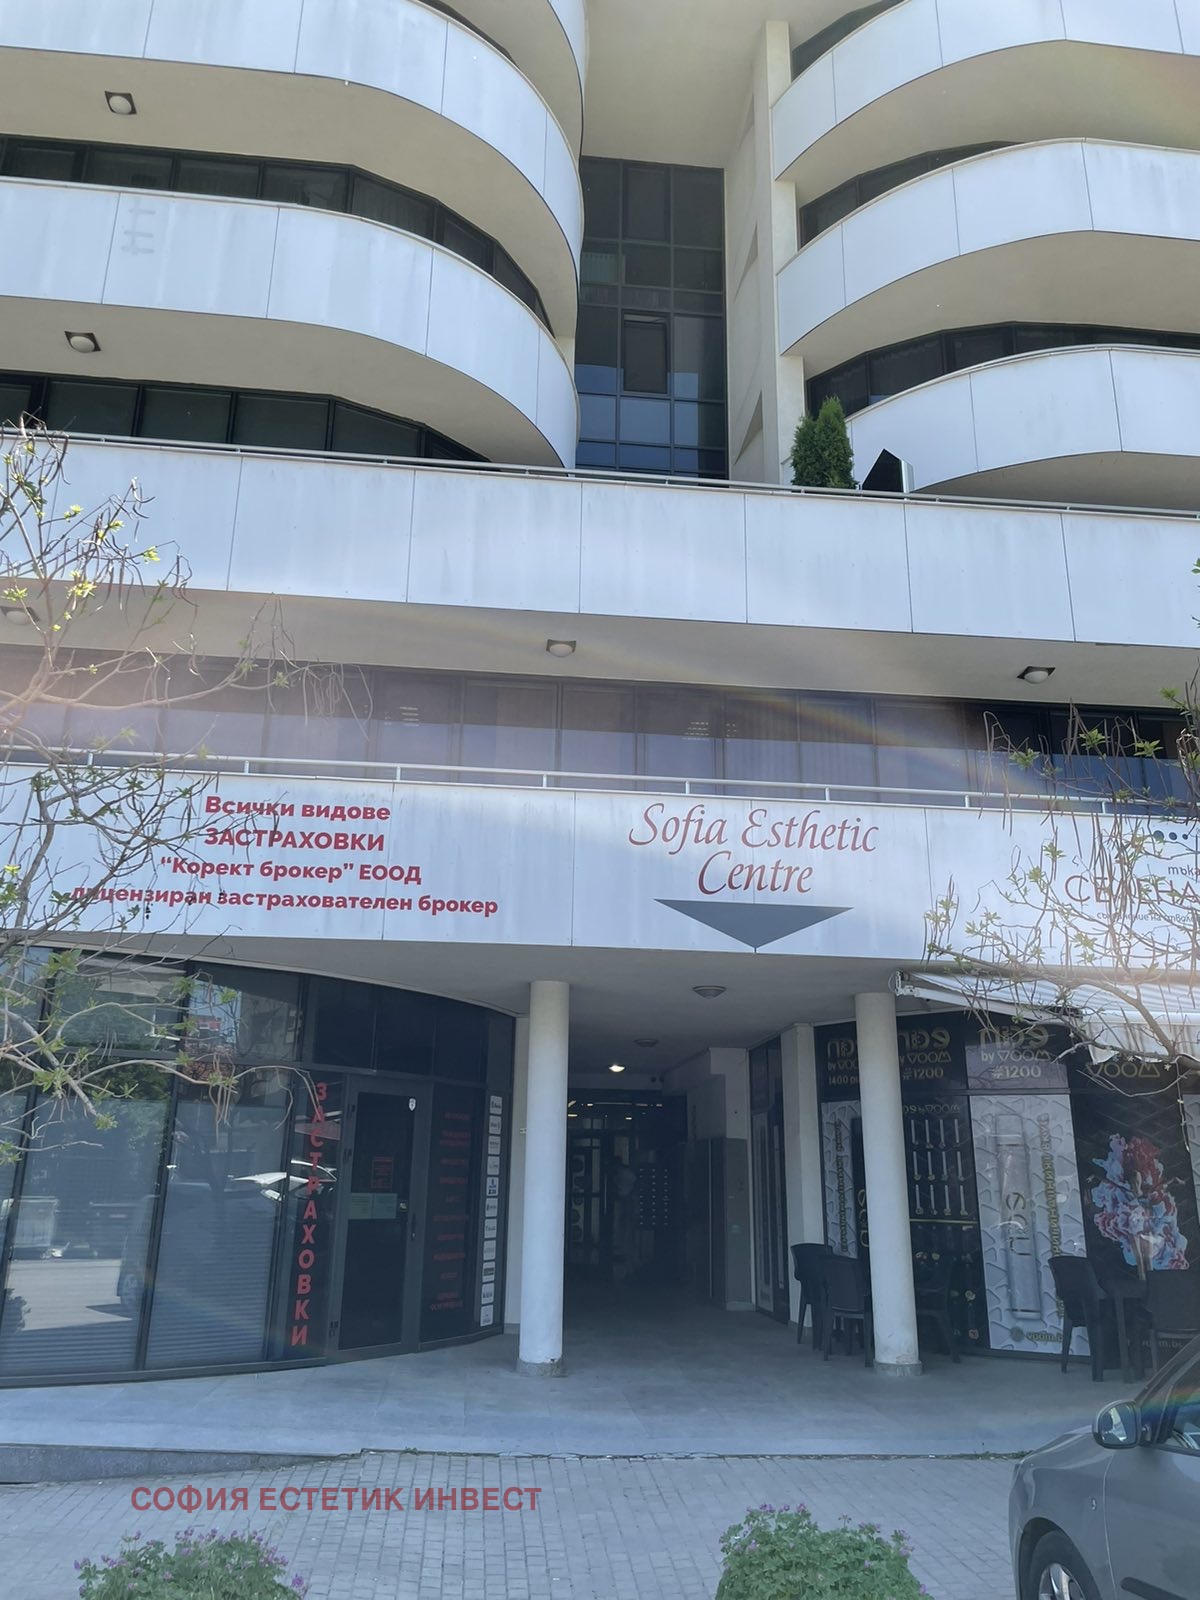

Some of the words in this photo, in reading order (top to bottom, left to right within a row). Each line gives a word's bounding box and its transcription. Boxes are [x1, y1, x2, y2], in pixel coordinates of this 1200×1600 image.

[205, 796, 296, 818] Всички
[301, 803, 391, 822] видове
[204, 828, 385, 852] ЗАСТРАХОВКИ
[629, 803, 727, 855] Sofia
[741, 808, 880, 852] Esthetic
[359, 864, 422, 885] ЕООД
[698, 851, 814, 896] Centre
[217, 891, 413, 916] застрахователен
[418, 895, 499, 918] брокер
[981, 1050, 996, 1064] by
[991, 1065, 1042, 1079] #1200
[290, 1082, 328, 1346] ЗАСТРАХОВКИ
